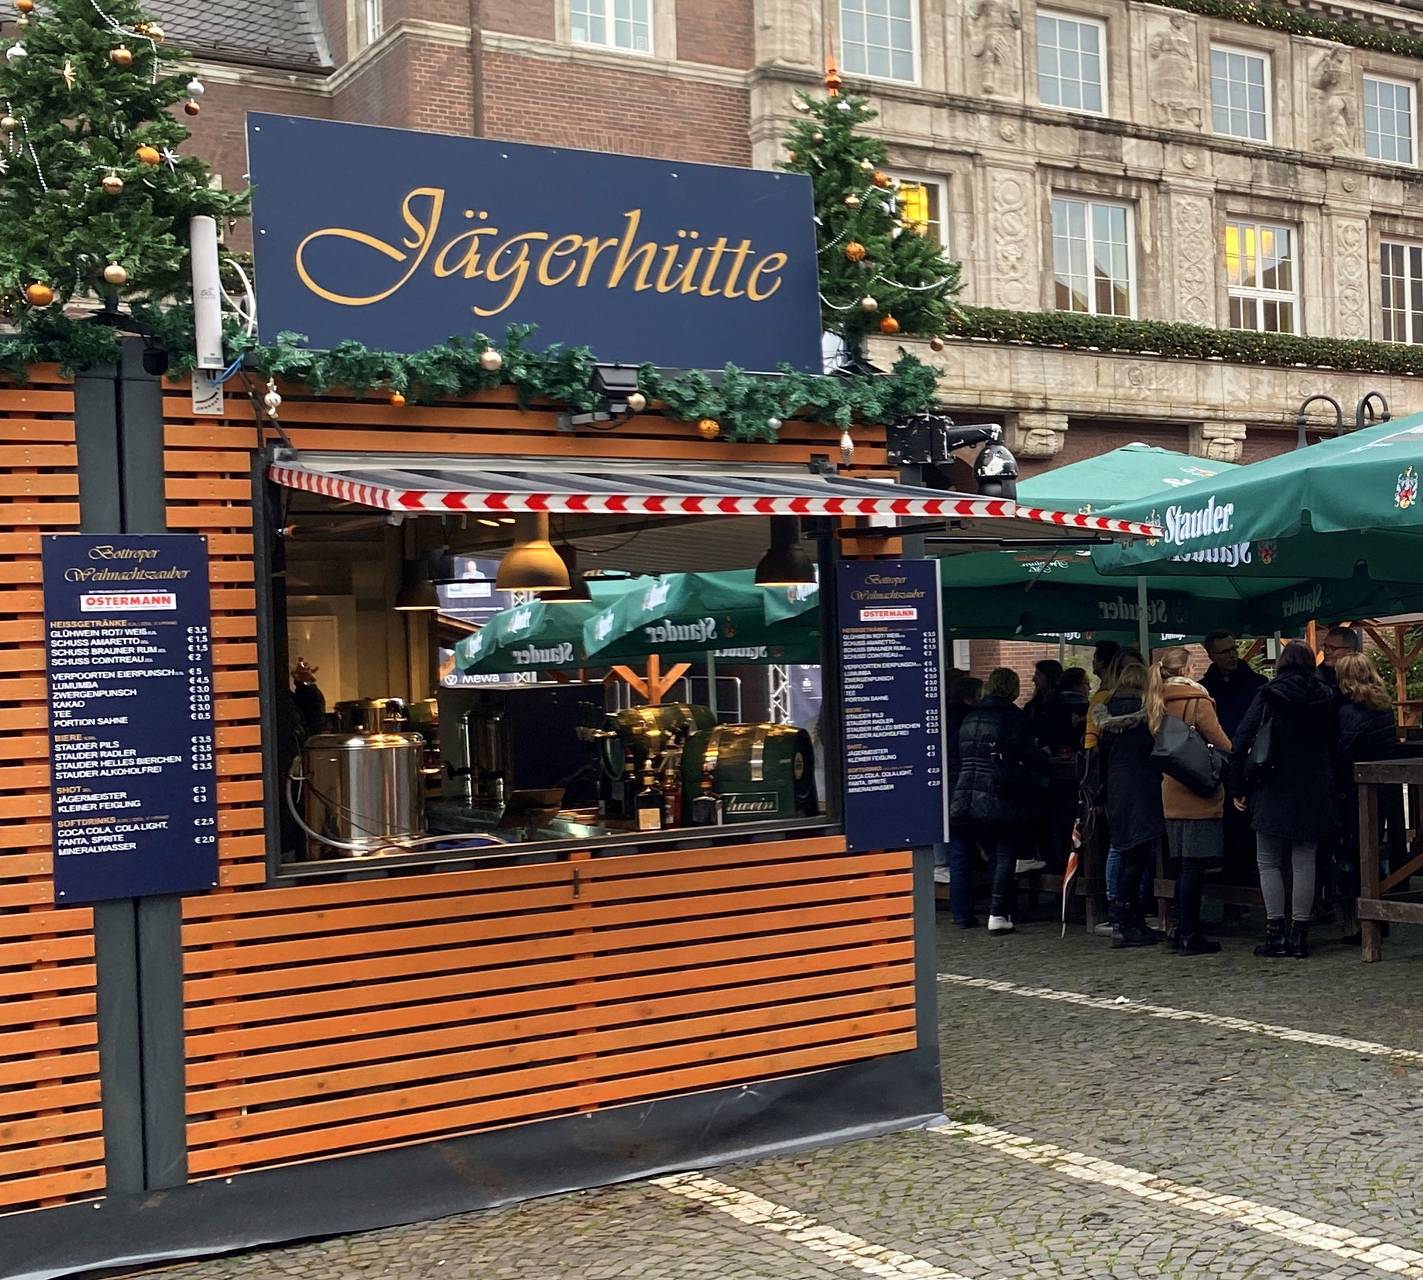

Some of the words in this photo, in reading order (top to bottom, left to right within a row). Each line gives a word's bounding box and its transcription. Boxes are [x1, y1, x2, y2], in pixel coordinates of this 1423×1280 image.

[295, 186, 788, 317] Jägerhütte
[1164, 495, 1234, 546] Stauder
[88, 545, 160, 562] Bottroper
[86, 596, 171, 606] OSTERMANN
[51, 629, 99, 638] GLÜHWEIN
[51, 638, 89, 648] SCHUSS
[91, 638, 140, 646] AMARETTO
[51, 648, 89, 656] SCHUSS
[91, 647, 135, 655] BRAUNER
[137, 646, 157, 654] RUM
[51, 658, 90, 666] SCHUSS
[92, 656, 144, 664] COINTREAU
[52, 671, 116, 680] VERPOORTEN
[117, 669, 174, 678] EIERPUNSCH
[52, 681, 98, 690] LUMUMBA
[53, 689, 137, 700] ZWERGENPUNSCH
[53, 701, 85, 709] KAKAO
[54, 710, 72, 718] TEE
[54, 719, 95, 728] PORTION
[54, 734, 82, 742] BIERE
[55, 742, 97, 751] STAUDER
[100, 741, 119, 749] PILS
[55, 752, 98, 760] STAUDER
[100, 749, 136, 758] RADLER
[56, 761, 98, 770] STAUDER
[100, 759, 135, 767] HELLES
[136, 756, 181, 764] BIERCHEN
[56, 771, 98, 779] STAUDER
[100, 766, 162, 776] ALKOHOLFREI
[57, 786, 81, 794] SHOT
[57, 792, 127, 804] JÄGERMEISTER
[58, 803, 97, 812] KLEINER
[99, 800, 141, 809] FEIGLING
[58, 817, 116, 827] SOFTDRINKS
[58, 829, 85, 837] COCA
[92, 835, 124, 843] SPRITE
[59, 843, 136, 856] MINERALWASSER
